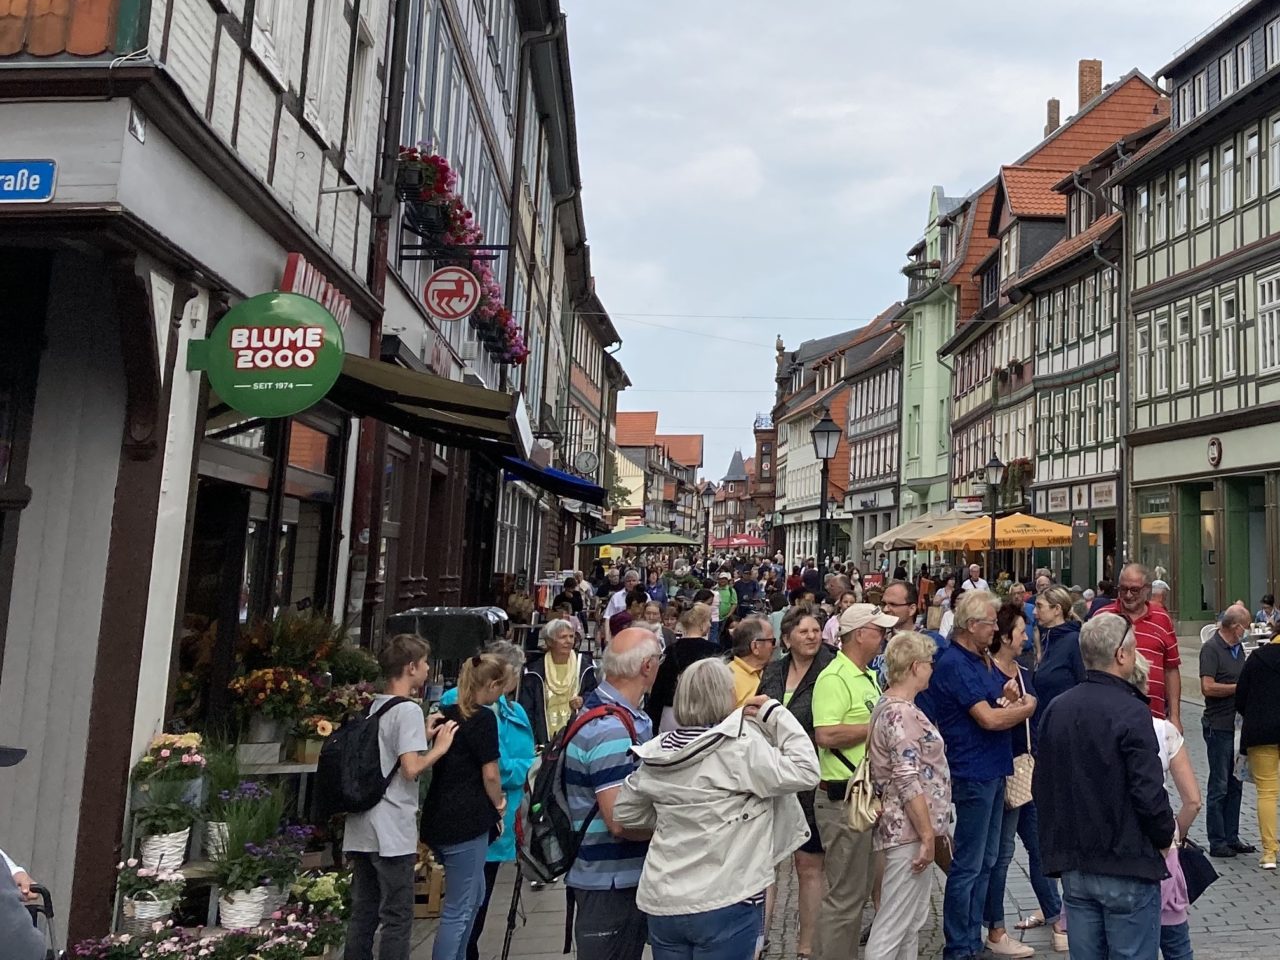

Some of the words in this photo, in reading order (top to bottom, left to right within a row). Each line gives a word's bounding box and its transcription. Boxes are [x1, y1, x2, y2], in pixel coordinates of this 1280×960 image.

[231, 327, 323, 349] BLUME
[236, 348, 316, 370] 2000
[253, 382, 274, 390] SEIT
[274, 381, 294, 390] 1974
